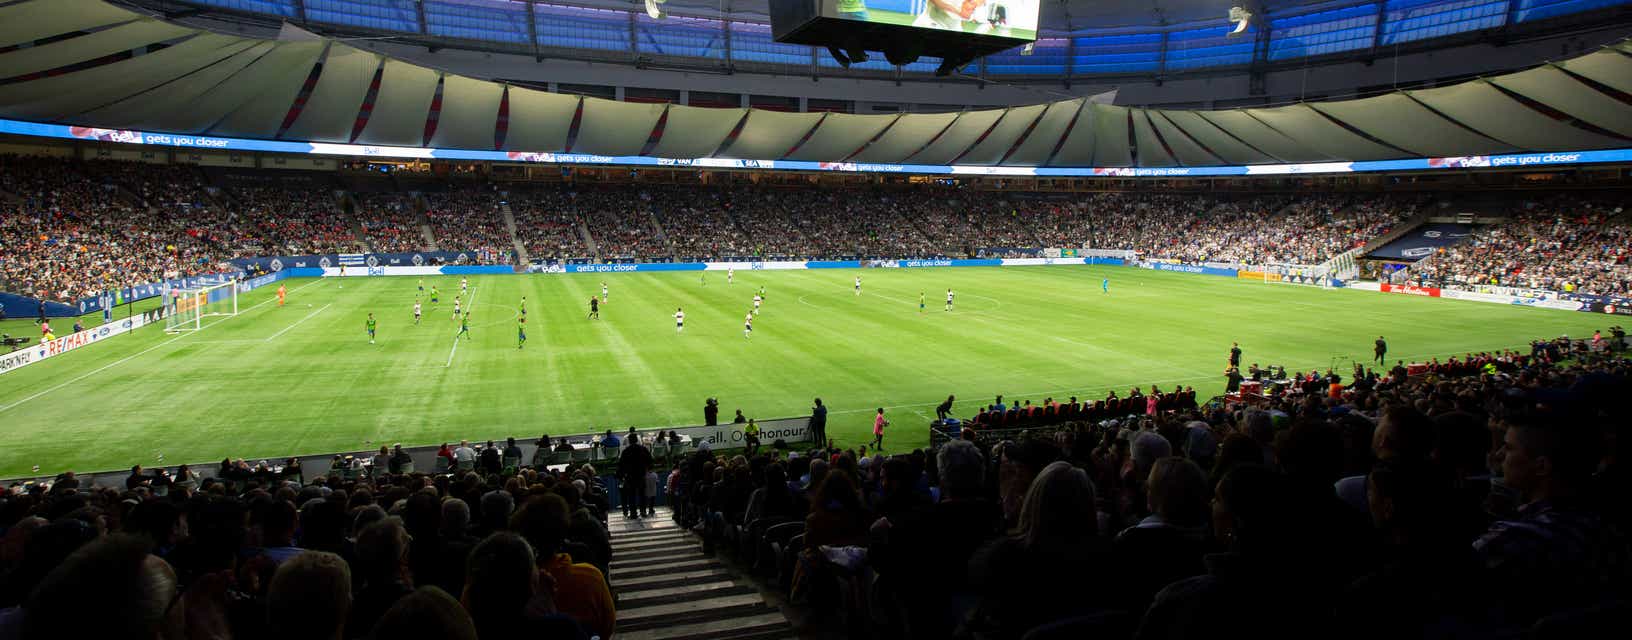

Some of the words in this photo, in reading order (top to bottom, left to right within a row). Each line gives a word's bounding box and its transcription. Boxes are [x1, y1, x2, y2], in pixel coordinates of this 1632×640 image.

[111, 131, 134, 143] Bell
[146, 134, 171, 145] gets
[173, 136, 194, 147] you
[196, 136, 229, 147] closer
[557, 154, 574, 163] gets
[575, 155, 590, 163] you
[591, 155, 613, 163] closer
[1493, 157, 1517, 167] gets
[1519, 155, 1541, 165] you
[1543, 153, 1581, 163] closer
[368, 267, 383, 275] Bell
[751, 262, 764, 270] Bell
[1402, 286, 1430, 296] Hortons
[49, 331, 89, 355] RE/MAX
[708, 431, 727, 444] all.
[759, 426, 807, 439] honour.
